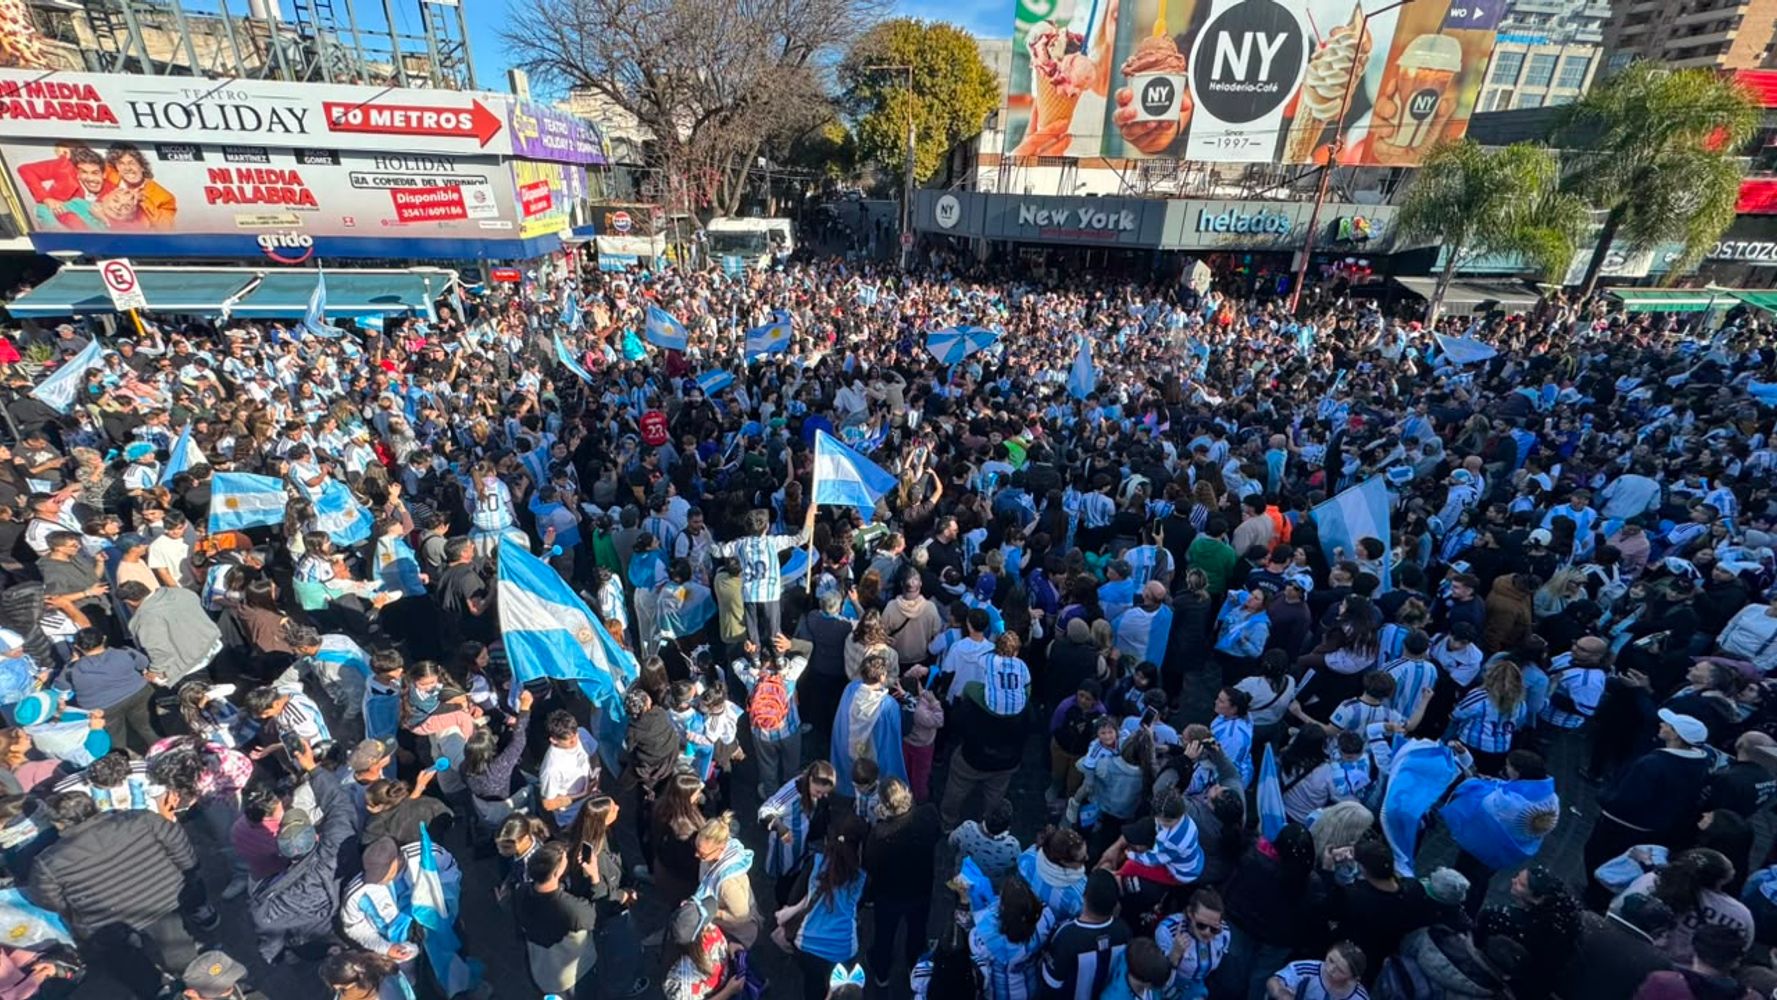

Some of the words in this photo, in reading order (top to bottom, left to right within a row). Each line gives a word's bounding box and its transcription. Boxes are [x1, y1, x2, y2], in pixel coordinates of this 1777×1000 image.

[1211, 30, 1289, 81] NY
[24, 81, 101, 102] MEDIA
[181, 88, 248, 101] TEATRO
[1148, 86, 1170, 102] NY
[1413, 95, 1436, 110] NY
[128, 101, 310, 135] HOLIDAY
[331, 106, 363, 125] 50
[369, 108, 473, 130] METROS
[1217, 137, 1249, 149] 1997
[374, 156, 456, 171] HOLIDAY
[206, 168, 233, 184] NI
[236, 168, 304, 186] MEDIA
[373, 176, 417, 186] COMEDIA
[204, 186, 319, 206] PALABRA
[397, 190, 460, 204] Disponible
[941, 203, 955, 216] NY
[1018, 203, 1071, 226] New
[1077, 207, 1136, 231] York
[1199, 208, 1291, 235] helados
[257, 231, 313, 251] grido
[997, 671, 1019, 690] 10
